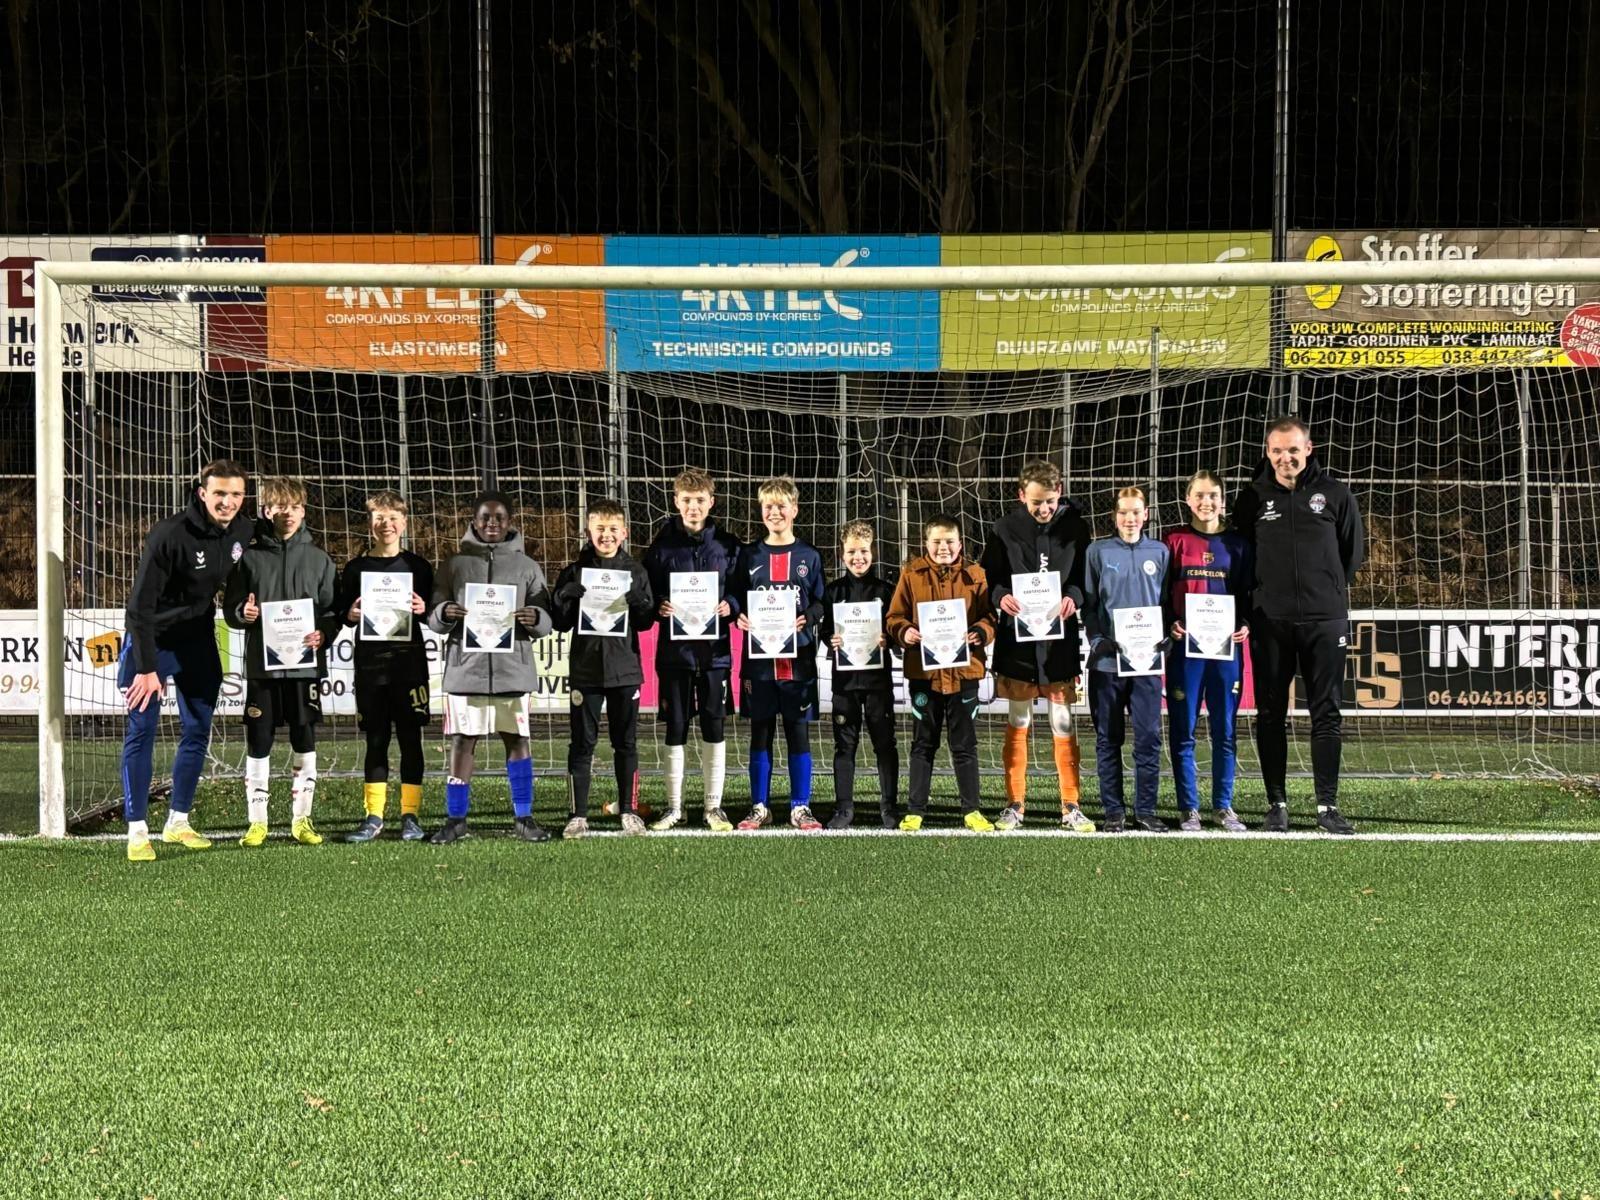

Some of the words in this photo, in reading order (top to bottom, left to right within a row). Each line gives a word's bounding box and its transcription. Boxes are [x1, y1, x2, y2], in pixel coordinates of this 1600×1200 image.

[1361, 233, 1478, 261] Stoffer
[1361, 281, 1575, 316] Stofferingen
[325, 313, 411, 325] COMPOUNDS
[414, 313, 431, 324] BY
[682, 312, 753, 321] COMPOUNDS
[756, 312, 770, 321] BY
[1290, 322, 1329, 334] VOOR
[1332, 322, 1355, 334] UW
[1357, 322, 1428, 334] COMPLETE
[996, 339, 1102, 355] DUURZAME
[1290, 334, 1337, 347] TAPIJT
[1347, 334, 1429, 347] GORDIJNEN
[1441, 334, 1469, 347] PVC
[1481, 334, 1554, 347] LAMINAAT
[8, 346, 83, 367] Hede
[368, 341, 508, 357] ELASTOMERN
[652, 341, 768, 357] TECHNISCHE
[771, 341, 893, 357] COMPOUNDS
[309, 683, 318, 700] 6
[409, 685, 428, 707] 10
[1428, 689, 1451, 706] 06
[1456, 689, 1548, 707] 40421663
